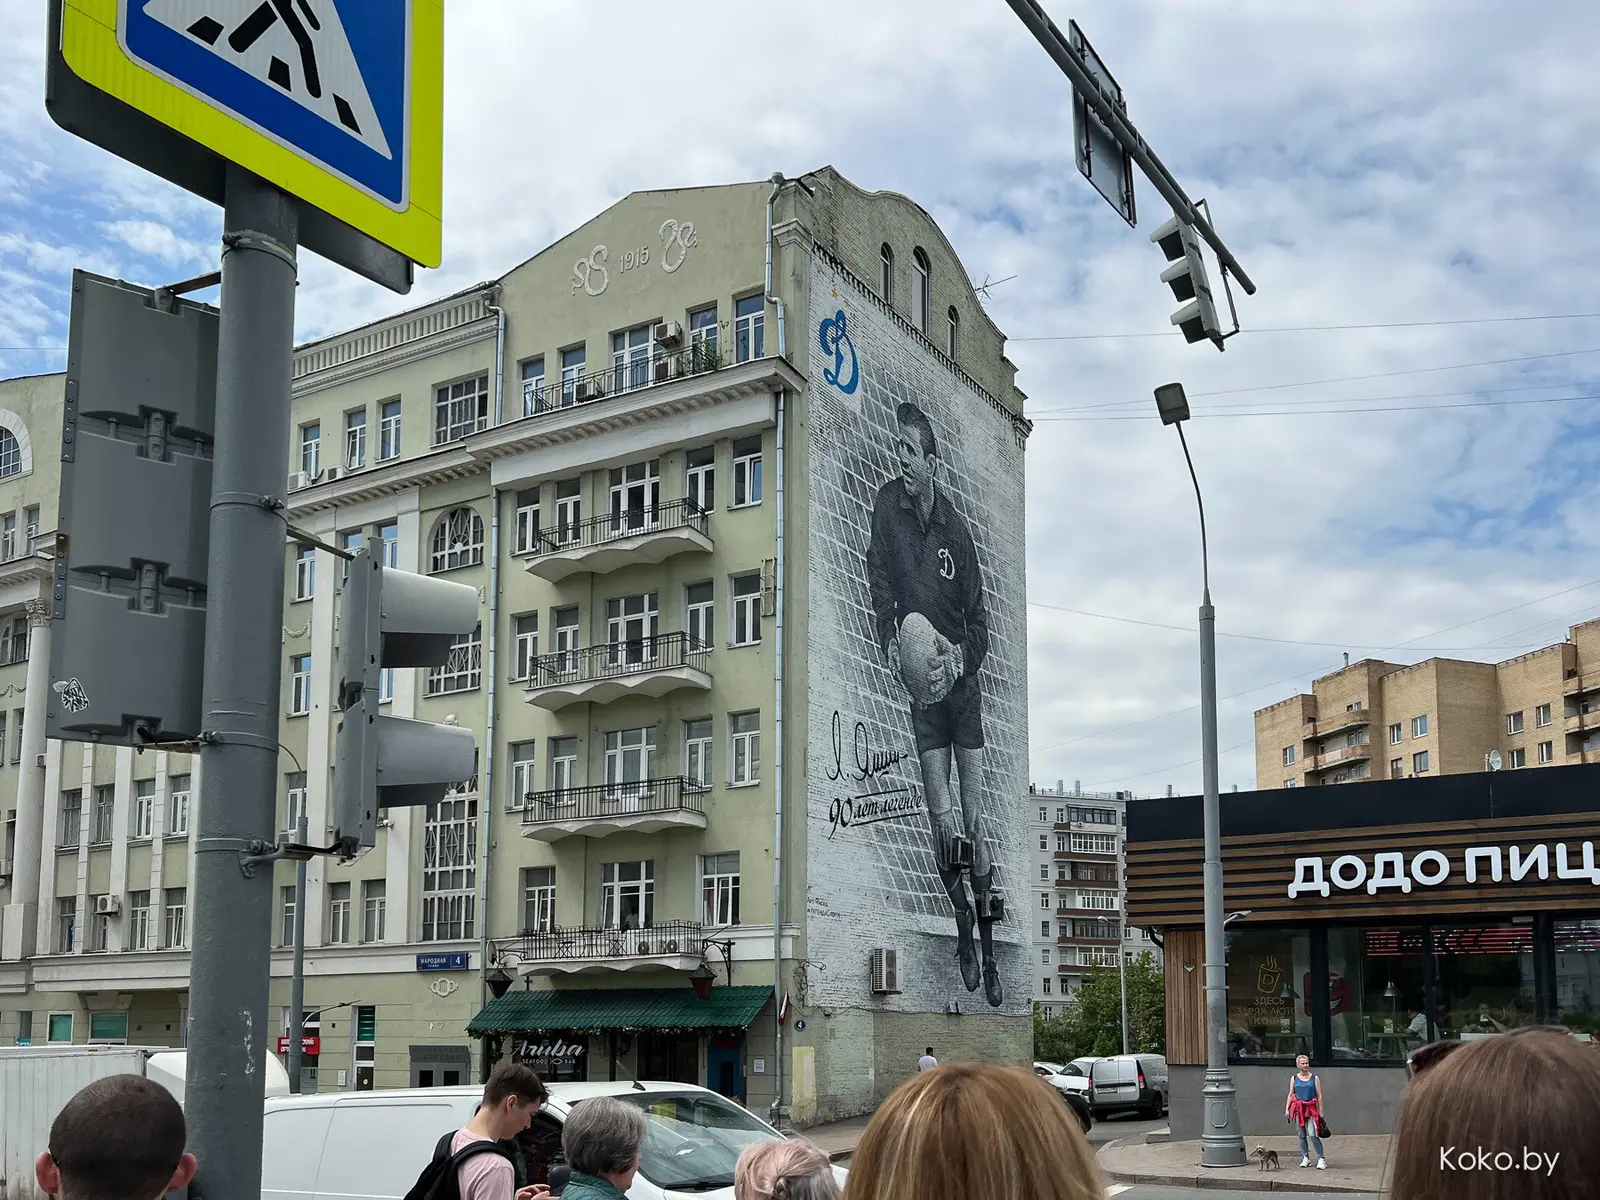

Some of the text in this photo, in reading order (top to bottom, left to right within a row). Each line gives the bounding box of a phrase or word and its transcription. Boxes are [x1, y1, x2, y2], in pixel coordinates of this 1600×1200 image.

[619, 245, 650, 273] 1915
[828, 797, 853, 841] 90
[854, 801, 878, 819] лет
[1287, 841, 1600, 899] ДОДО ПИЦ
[455, 956, 461, 965] 4
[1253, 996, 1285, 1006] ЗДЕСЬ
[511, 1038, 585, 1057] Aruba
